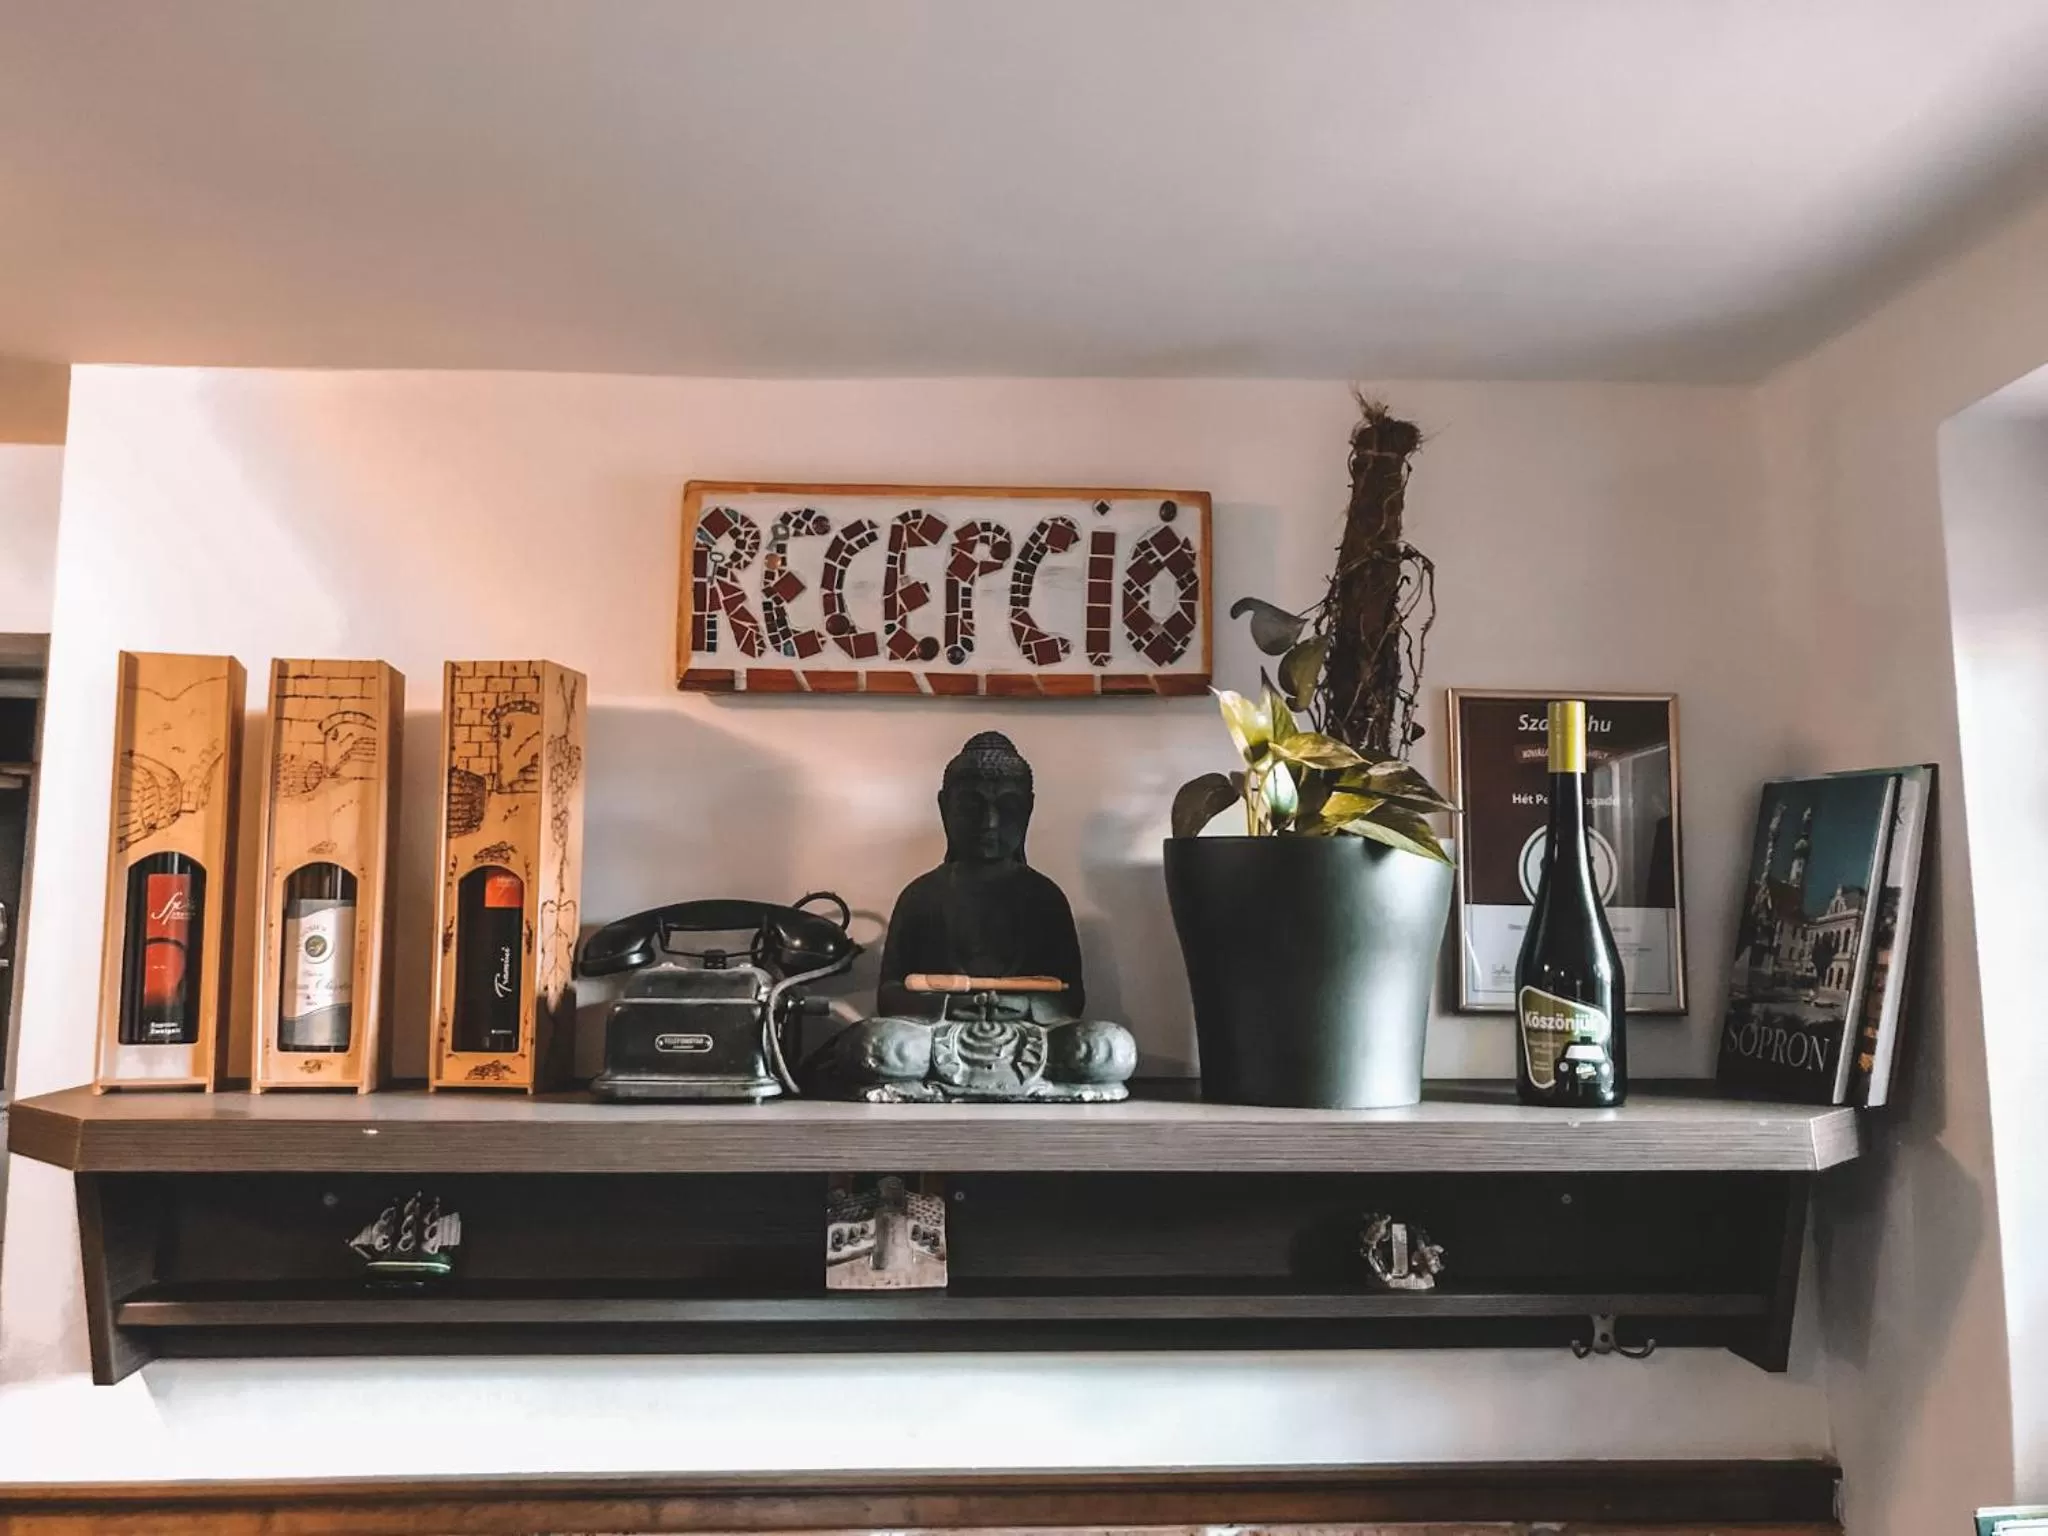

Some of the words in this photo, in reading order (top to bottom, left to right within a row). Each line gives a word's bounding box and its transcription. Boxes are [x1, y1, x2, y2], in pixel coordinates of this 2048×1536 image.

[1512, 793, 1533, 804] Hét
[1524, 1010, 1597, 1035] Köszönjü
[1727, 1023, 1831, 1072] SOPRON
